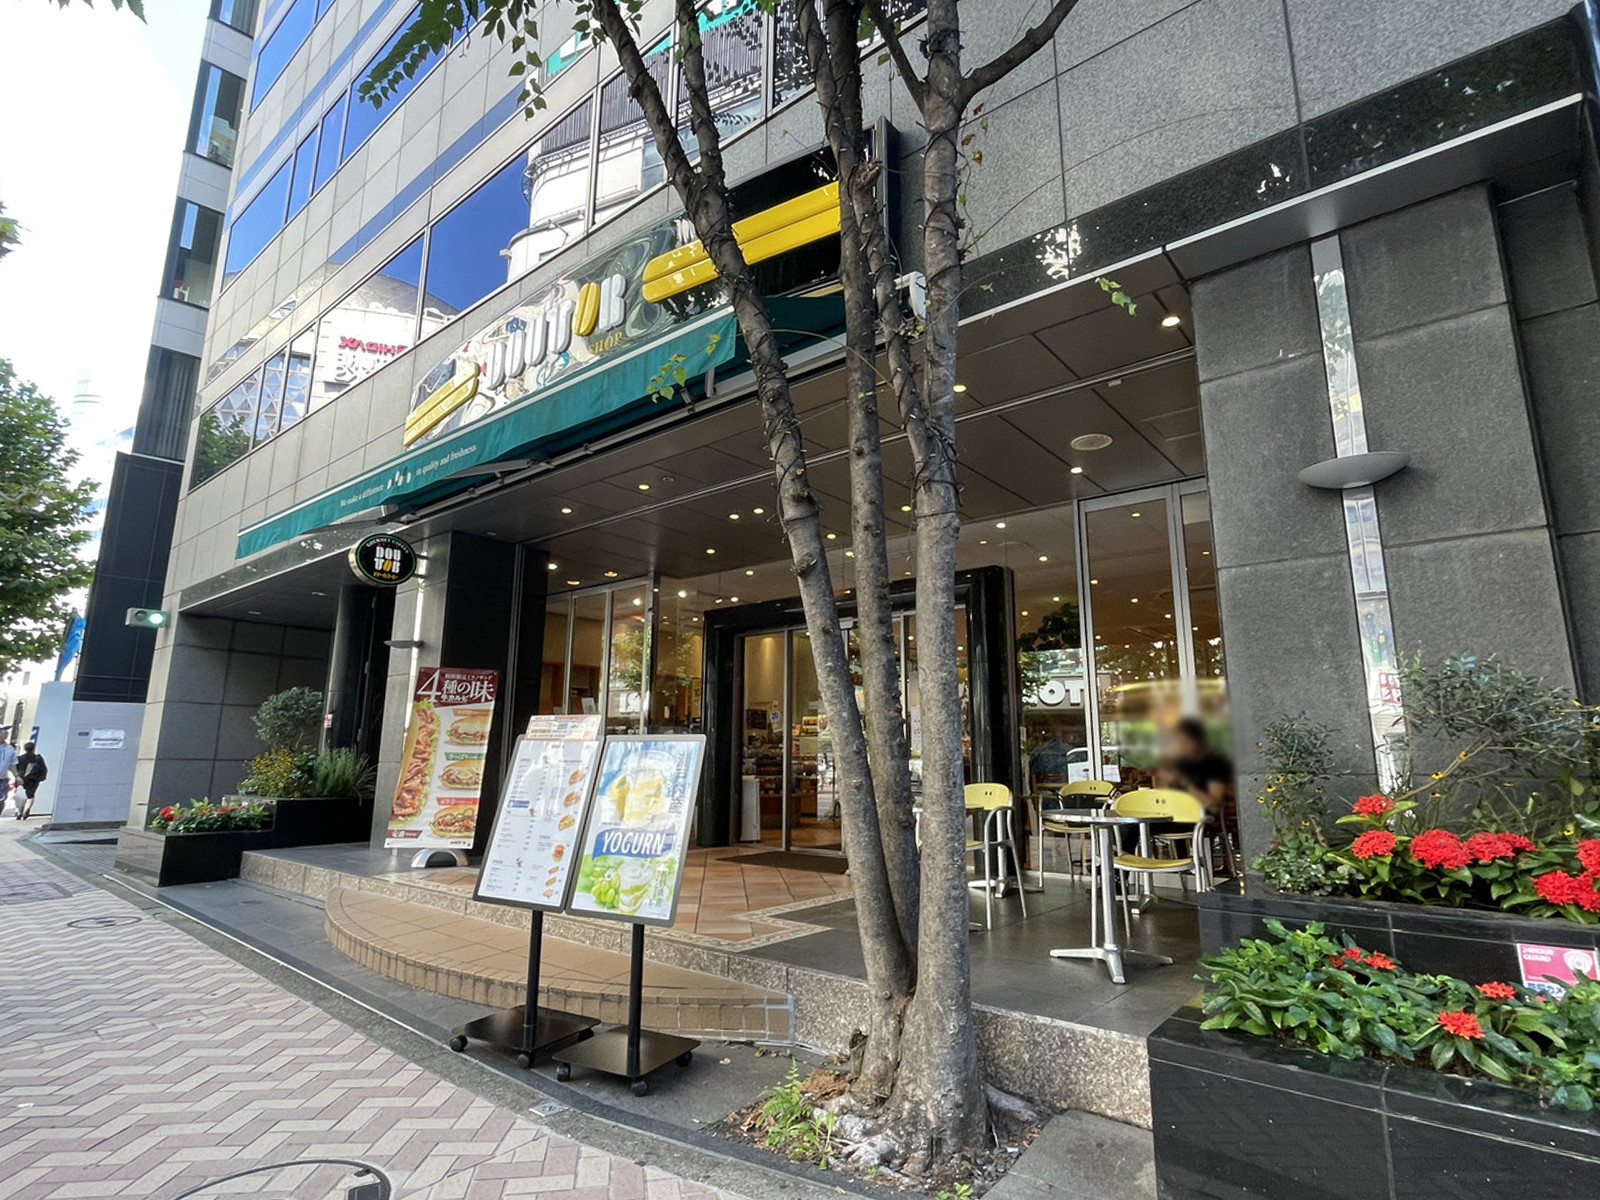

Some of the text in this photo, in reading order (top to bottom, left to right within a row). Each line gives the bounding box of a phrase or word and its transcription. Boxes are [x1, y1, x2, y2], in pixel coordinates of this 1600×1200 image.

[489, 272, 627, 391] DOUTOR
[590, 331, 623, 354] SHOP
[422, 461, 438, 474] quality
[440, 453, 450, 465] and
[450, 444, 477, 460] freshness
[373, 557, 401, 574] TOR
[375, 546, 402, 562] DOU
[602, 831, 666, 855] YOGURN
